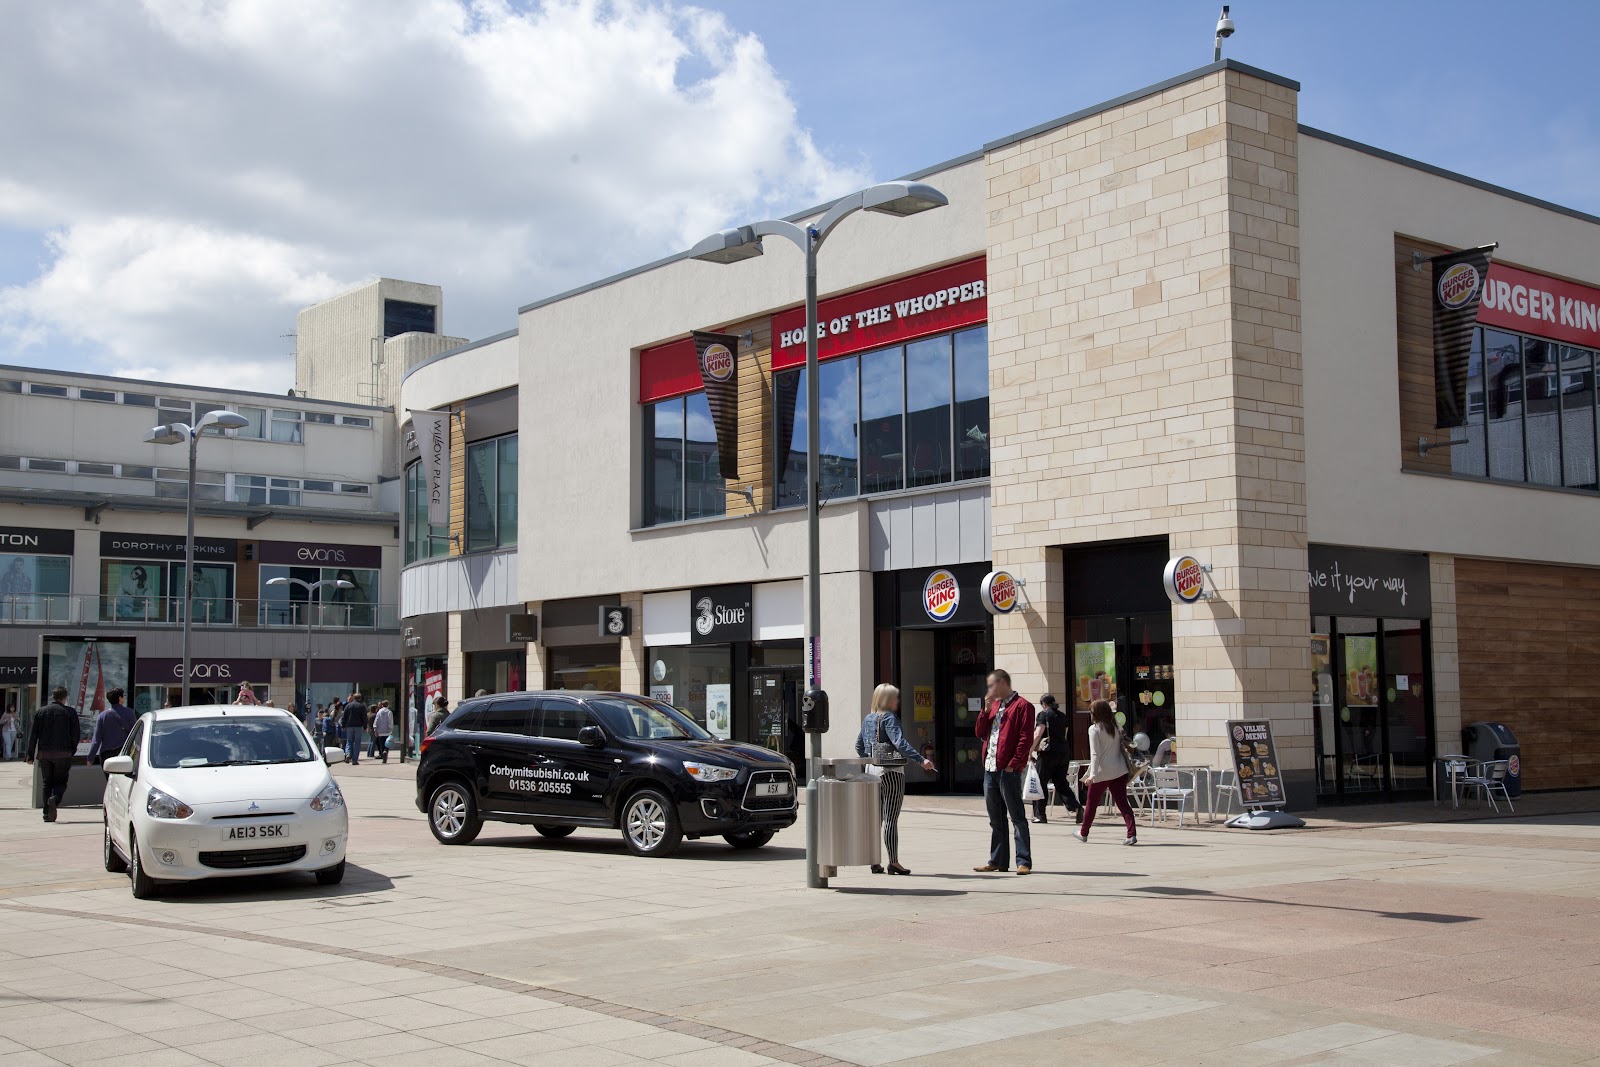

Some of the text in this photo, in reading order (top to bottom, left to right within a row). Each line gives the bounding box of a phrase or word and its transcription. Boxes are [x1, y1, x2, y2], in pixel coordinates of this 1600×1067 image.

[1442, 269, 1474, 292] BURGER
[1443, 277, 1475, 304] KING
[780, 279, 986, 348] HOE OF THE WHOPPER
[1479, 278, 1600, 333] URGER KIN
[706, 351, 730, 364] BURGER
[707, 358, 731, 372] KING
[429, 419, 444, 505] WILLOW PLACE
[112, 540, 172, 552] DOROTHY
[1176, 564, 1200, 582] BURGER
[1178, 571, 1201, 594] KING
[927, 578, 954, 598] BURGER
[991, 579, 1014, 595] BURGER
[1330, 560, 1341, 592] it
[1345, 574, 1379, 604] your
[1382, 576, 1408, 606] way
[928, 586, 956, 611] KING
[993, 586, 1016, 605] KING
[608, 610, 624, 634] 3
[695, 596, 715, 635] 3
[715, 604, 745, 626] Store
[1244, 725, 1266, 733] VALUE
[1245, 732, 1267, 740] MENU
[489, 764, 590, 782] Corbymitsubishi.co.uk
[509, 779, 571, 795] 01536 205555
[768, 784, 778, 794] ASX
[229, 825, 283, 839] AE13 SSK
